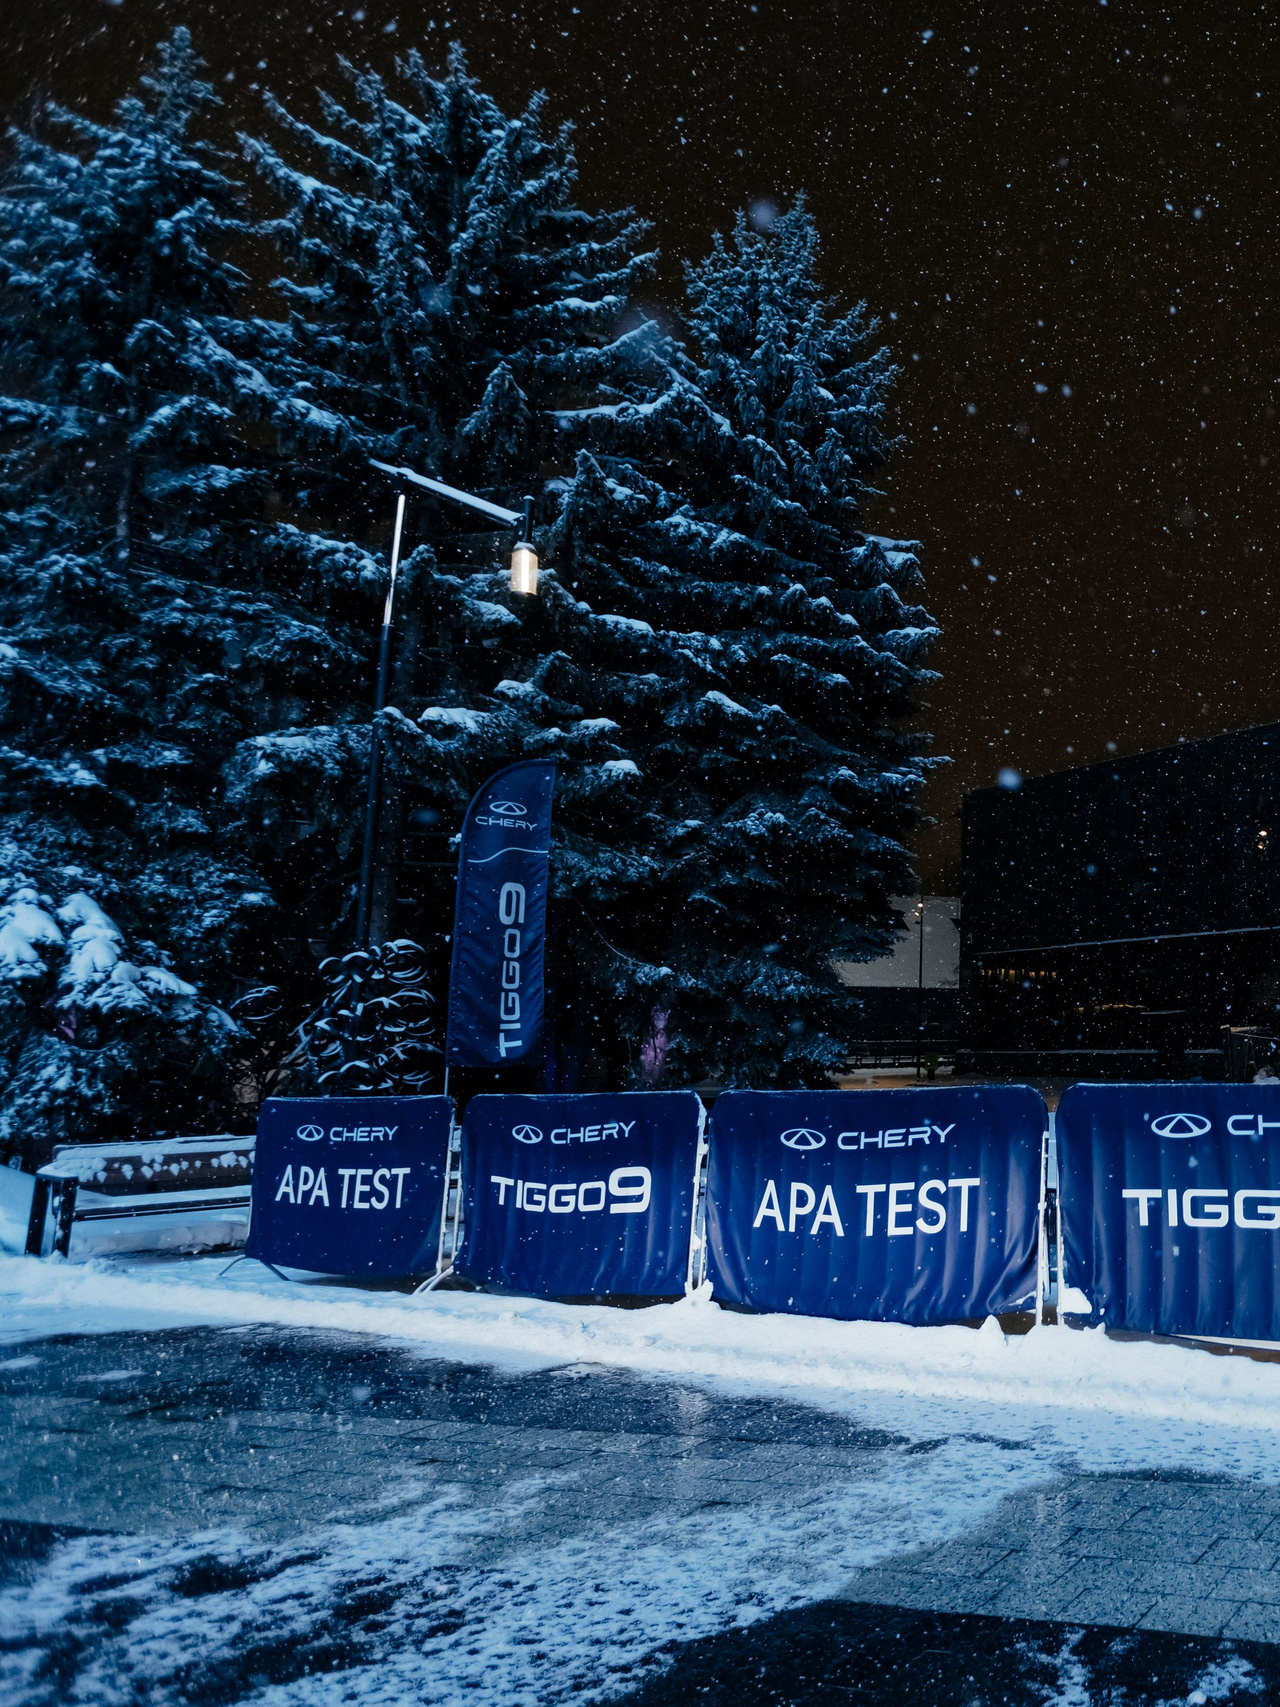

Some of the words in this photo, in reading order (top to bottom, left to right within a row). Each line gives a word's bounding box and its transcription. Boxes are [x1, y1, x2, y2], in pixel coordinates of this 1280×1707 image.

[475, 816, 538, 831] CHERY
[330, 1125, 399, 1142] CHERY
[551, 1121, 636, 1144] CHERY
[837, 1123, 956, 1150] CHERY
[275, 1164, 330, 1207] APA
[338, 1167, 411, 1209] TEST
[753, 1180, 844, 1236] APA
[856, 1178, 980, 1237] TEST
